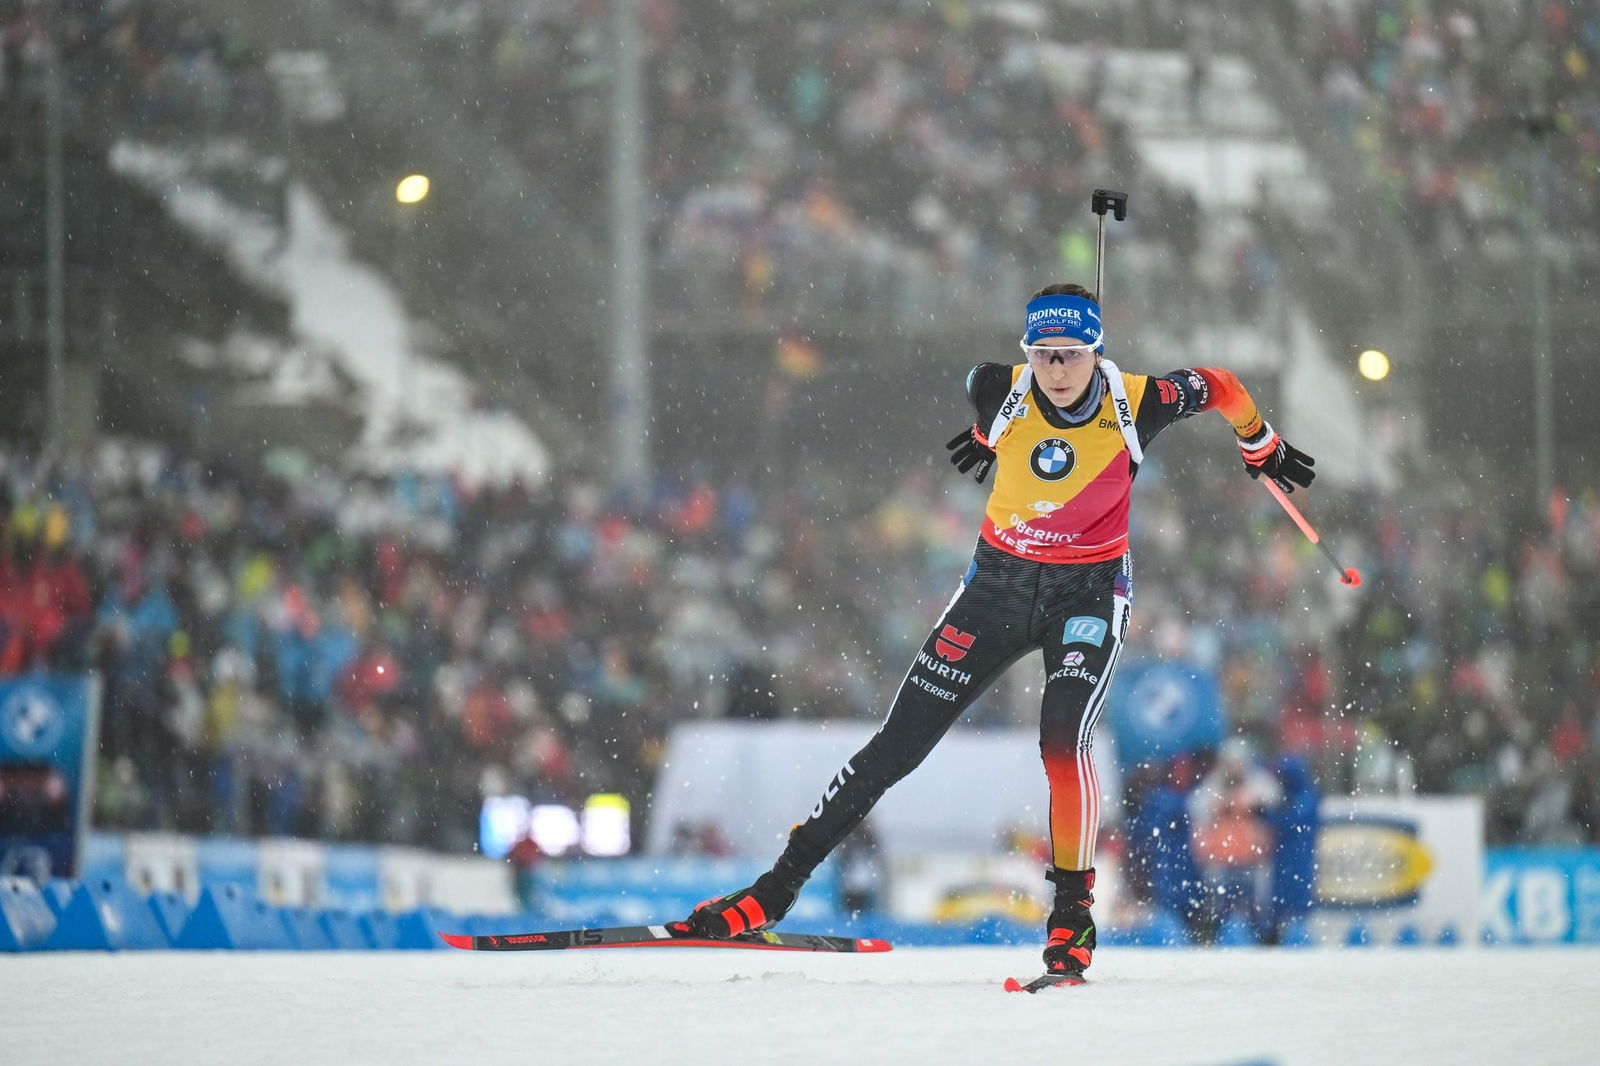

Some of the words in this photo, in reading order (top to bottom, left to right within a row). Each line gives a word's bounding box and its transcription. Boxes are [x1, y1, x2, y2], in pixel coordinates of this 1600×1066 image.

[1028, 307, 1082, 324] ERDINGER
[1000, 391, 1023, 420] JOKA
[1115, 398, 1132, 428] JOKA
[1039, 439, 1073, 454] BMW
[918, 650, 972, 685] WÜRTH
[919, 678, 959, 702] TERREX
